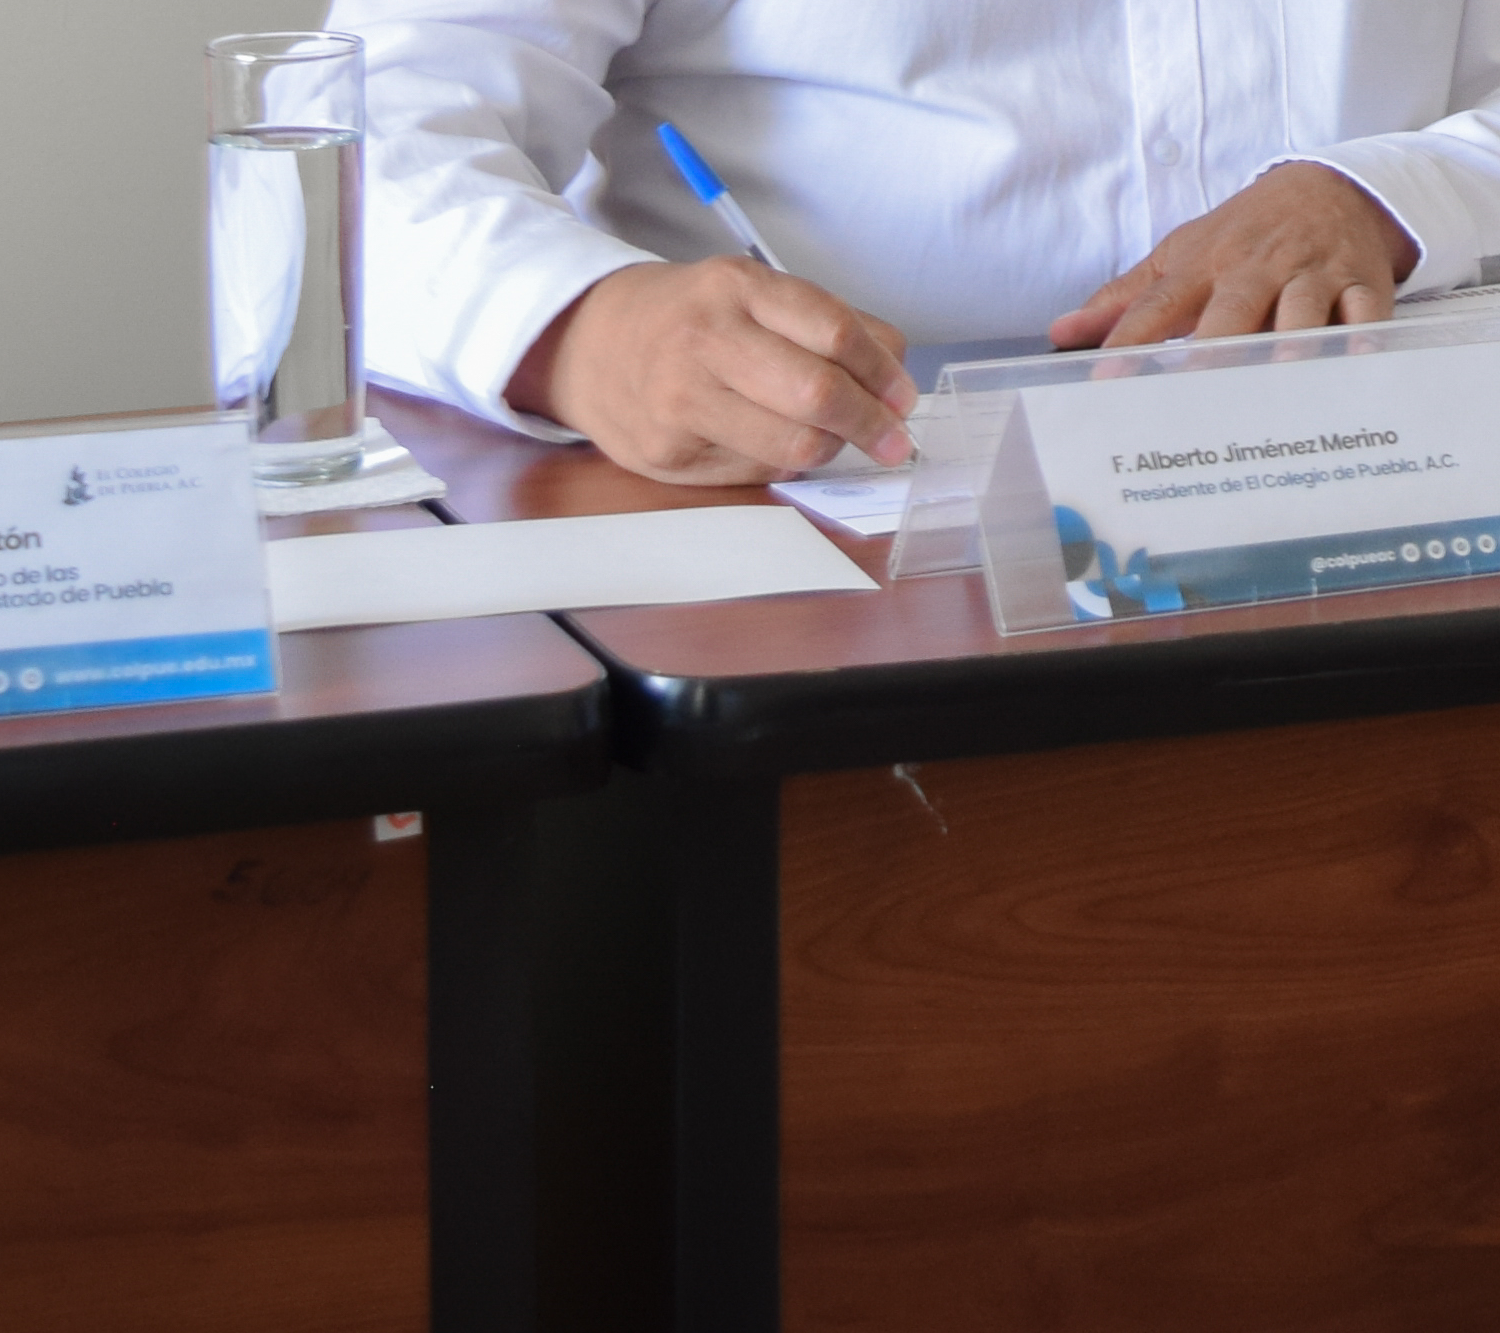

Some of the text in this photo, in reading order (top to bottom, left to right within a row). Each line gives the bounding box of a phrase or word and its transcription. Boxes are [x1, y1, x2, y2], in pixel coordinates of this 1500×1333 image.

[1112, 428, 1398, 474] F. Alberto Jiménez Merino
[1123, 454, 1460, 503] Presidente de El Colegio de Puebla, A.C.
[11, 567, 41, 586] de
[45, 565, 80, 583] las
[60, 584, 90, 604] de
[94, 578, 174, 602] Puebla
